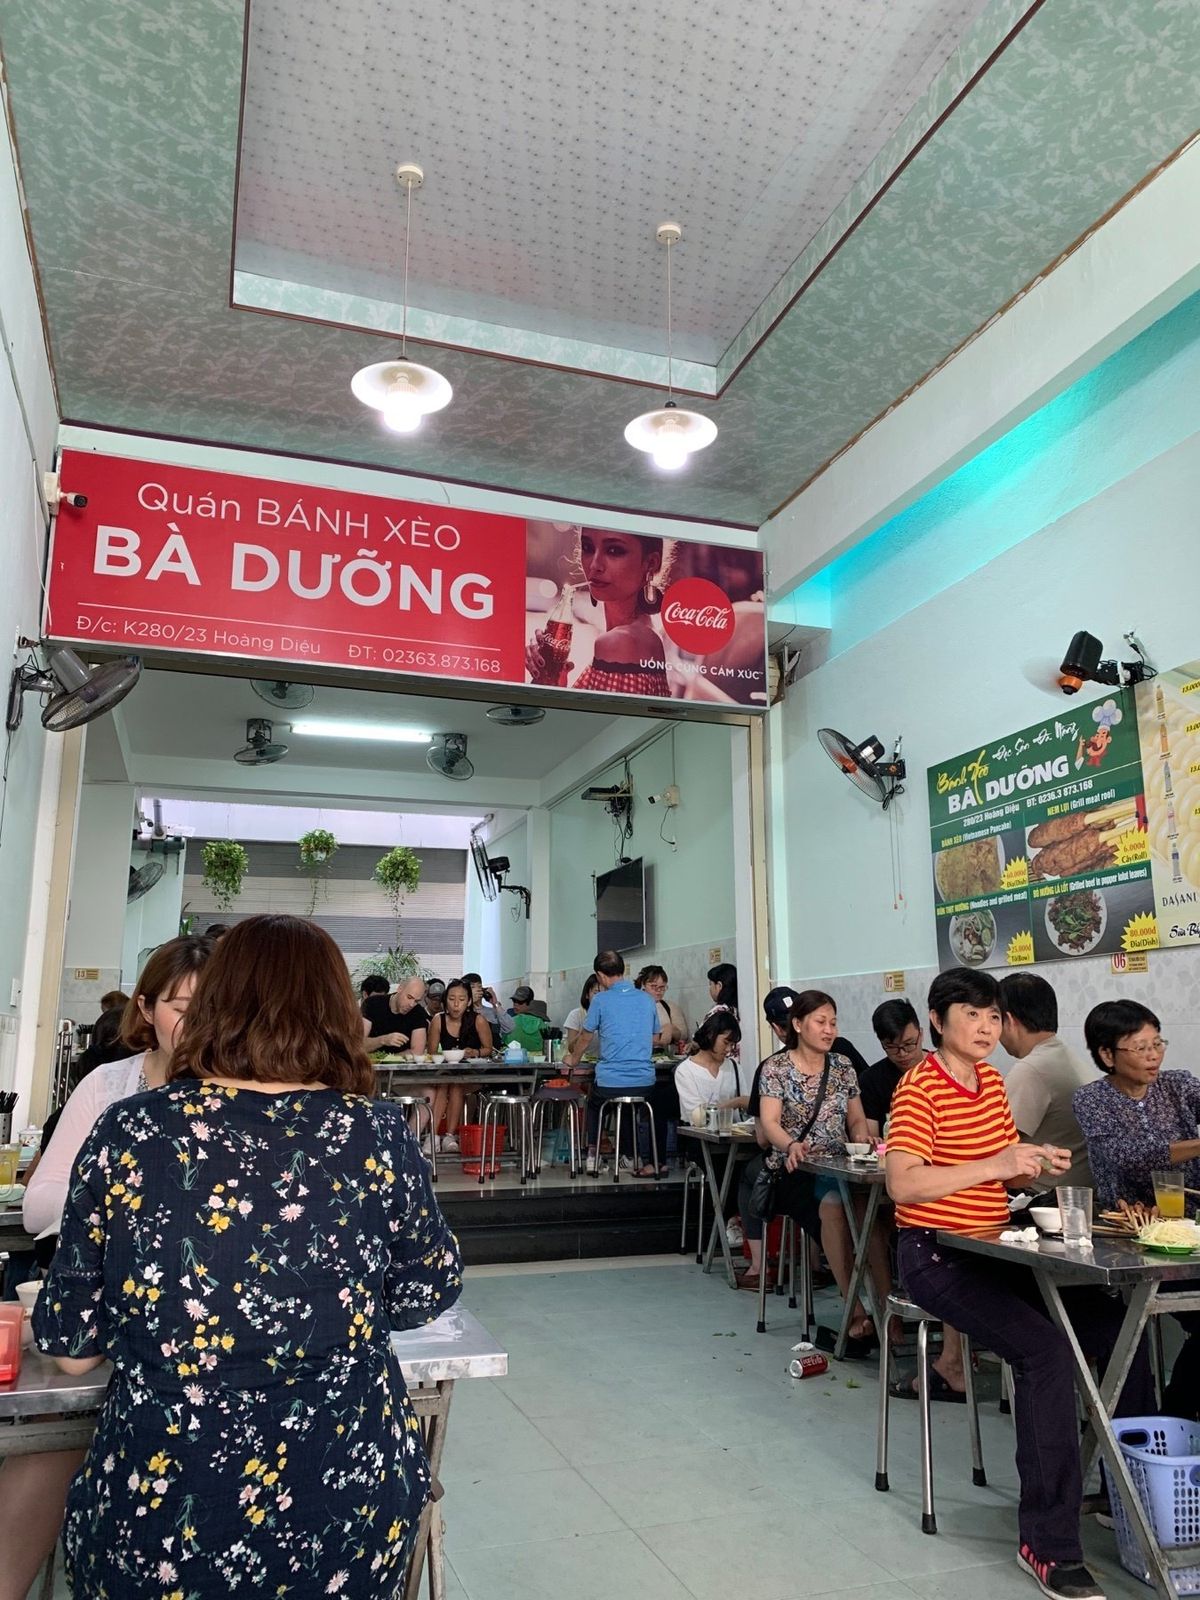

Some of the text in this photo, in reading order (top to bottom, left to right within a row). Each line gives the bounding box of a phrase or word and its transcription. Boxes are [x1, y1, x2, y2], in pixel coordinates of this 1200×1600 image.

[137, 482, 461, 551] Quán BÁNH XÈO
[93, 522, 495, 620] BÀ DƯỠNG
[664, 600, 731, 630] Coca-Cola
[76, 615, 501, 673] Đ/c: K280/23 Hoàng Diệu ĐT: 02363.873.168
[1063, 779, 1094, 796] 873.168
[1162, 892, 1197, 906] DASANI
[1113, 953, 1126, 968] 06
